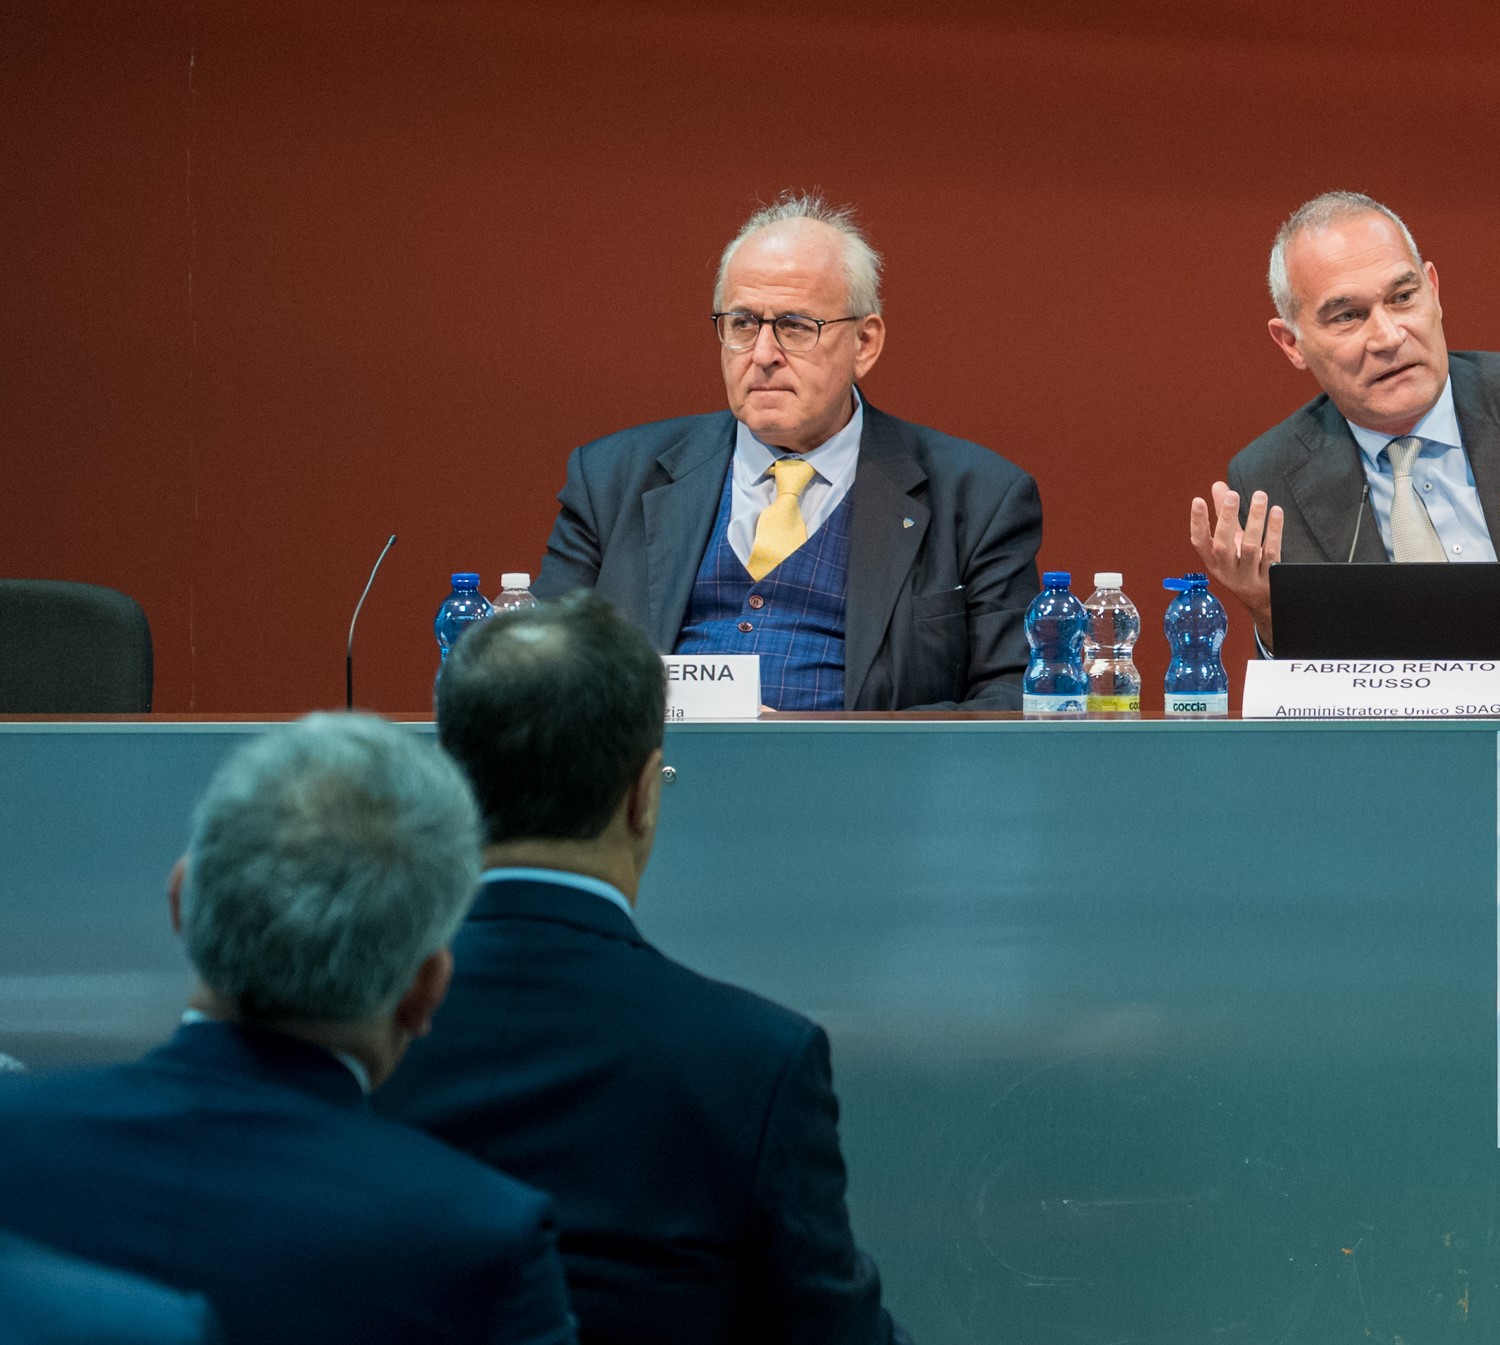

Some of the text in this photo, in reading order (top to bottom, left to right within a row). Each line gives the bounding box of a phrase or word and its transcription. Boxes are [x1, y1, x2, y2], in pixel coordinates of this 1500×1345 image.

[665, 663, 735, 681] ERNA
[1290, 662, 1496, 674] FABRIZIO RENATO
[1352, 677, 1431, 689] RUSSO
[1275, 705, 1399, 716] Amministratore
[1404, 706, 1450, 715] Unico
